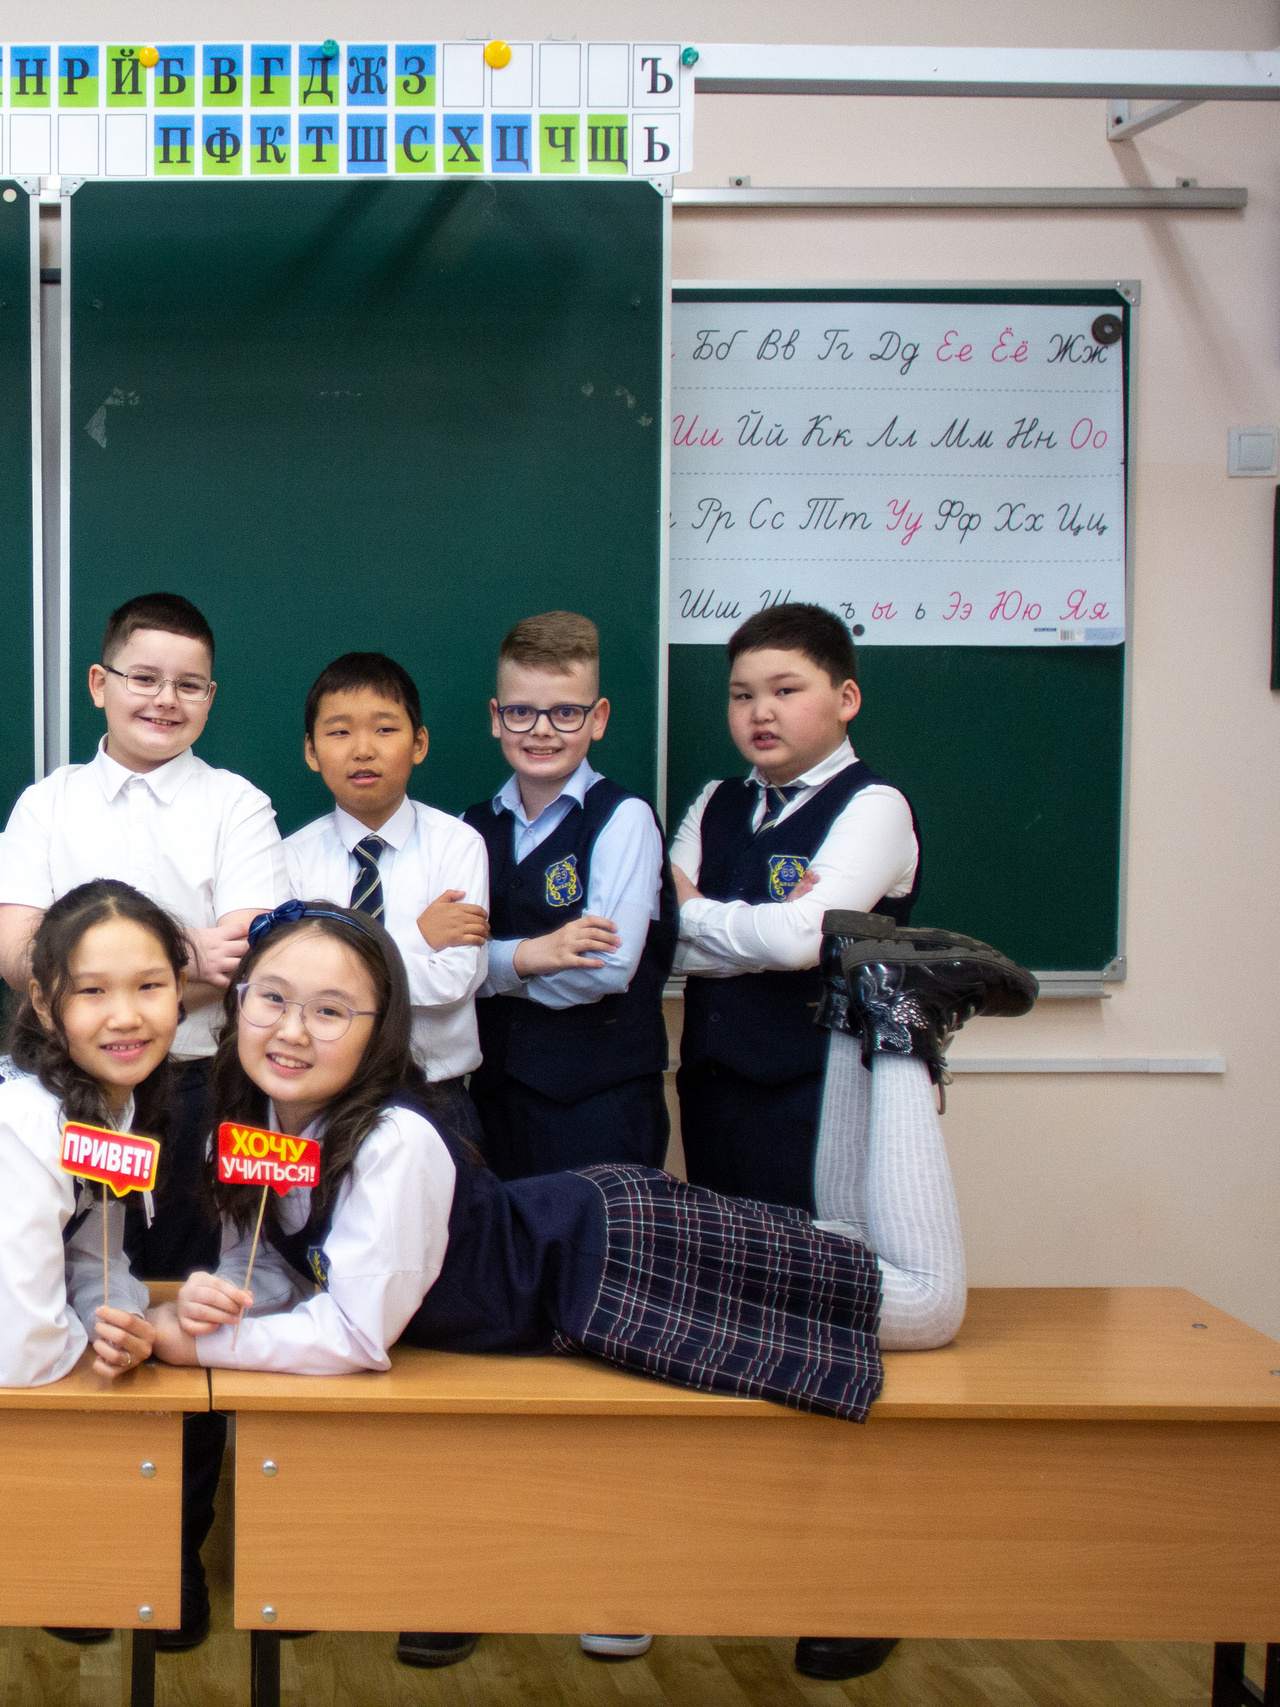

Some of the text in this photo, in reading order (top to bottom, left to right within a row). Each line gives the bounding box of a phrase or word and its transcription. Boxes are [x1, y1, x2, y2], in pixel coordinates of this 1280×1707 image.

[16, 58, 47, 95] Н
[63, 58, 89, 95] Р
[111, 48, 142, 95] Й
[159, 58, 186, 95] Б
[210, 57, 237, 95] В
[259, 57, 283, 94] Г
[303, 57, 333, 104] Д
[348, 57, 387, 95] Ж
[402, 56, 427, 95] З
[641, 57, 673, 94] Ъ
[159, 127, 191, 164] П
[205, 127, 241, 164] Ф
[256, 126, 286, 164] К
[306, 126, 333, 162] Т
[348, 126, 387, 162] Ш
[403, 126, 428, 163] С
[447, 126, 480, 162] Х
[496, 126, 529, 171] Ц
[544, 127, 575, 163] Ч
[588, 126, 628, 172] Щ
[644, 127, 670, 163] Ь
[693, 326, 1108, 376] Бб Вв Гг Дд Ее Ёё Жж
[672, 409, 1109, 449] Ии Йй Кк Лл Мм Нн Оо
[691, 497, 1109, 546] Рр Сс Тт Уу Фф Хх Цц
[63, 1132, 153, 1180] ПРИВЕТ!
[231, 1127, 308, 1163] ХОЧУ
[222, 1156, 316, 1183] УЧИТЬСЯ!
